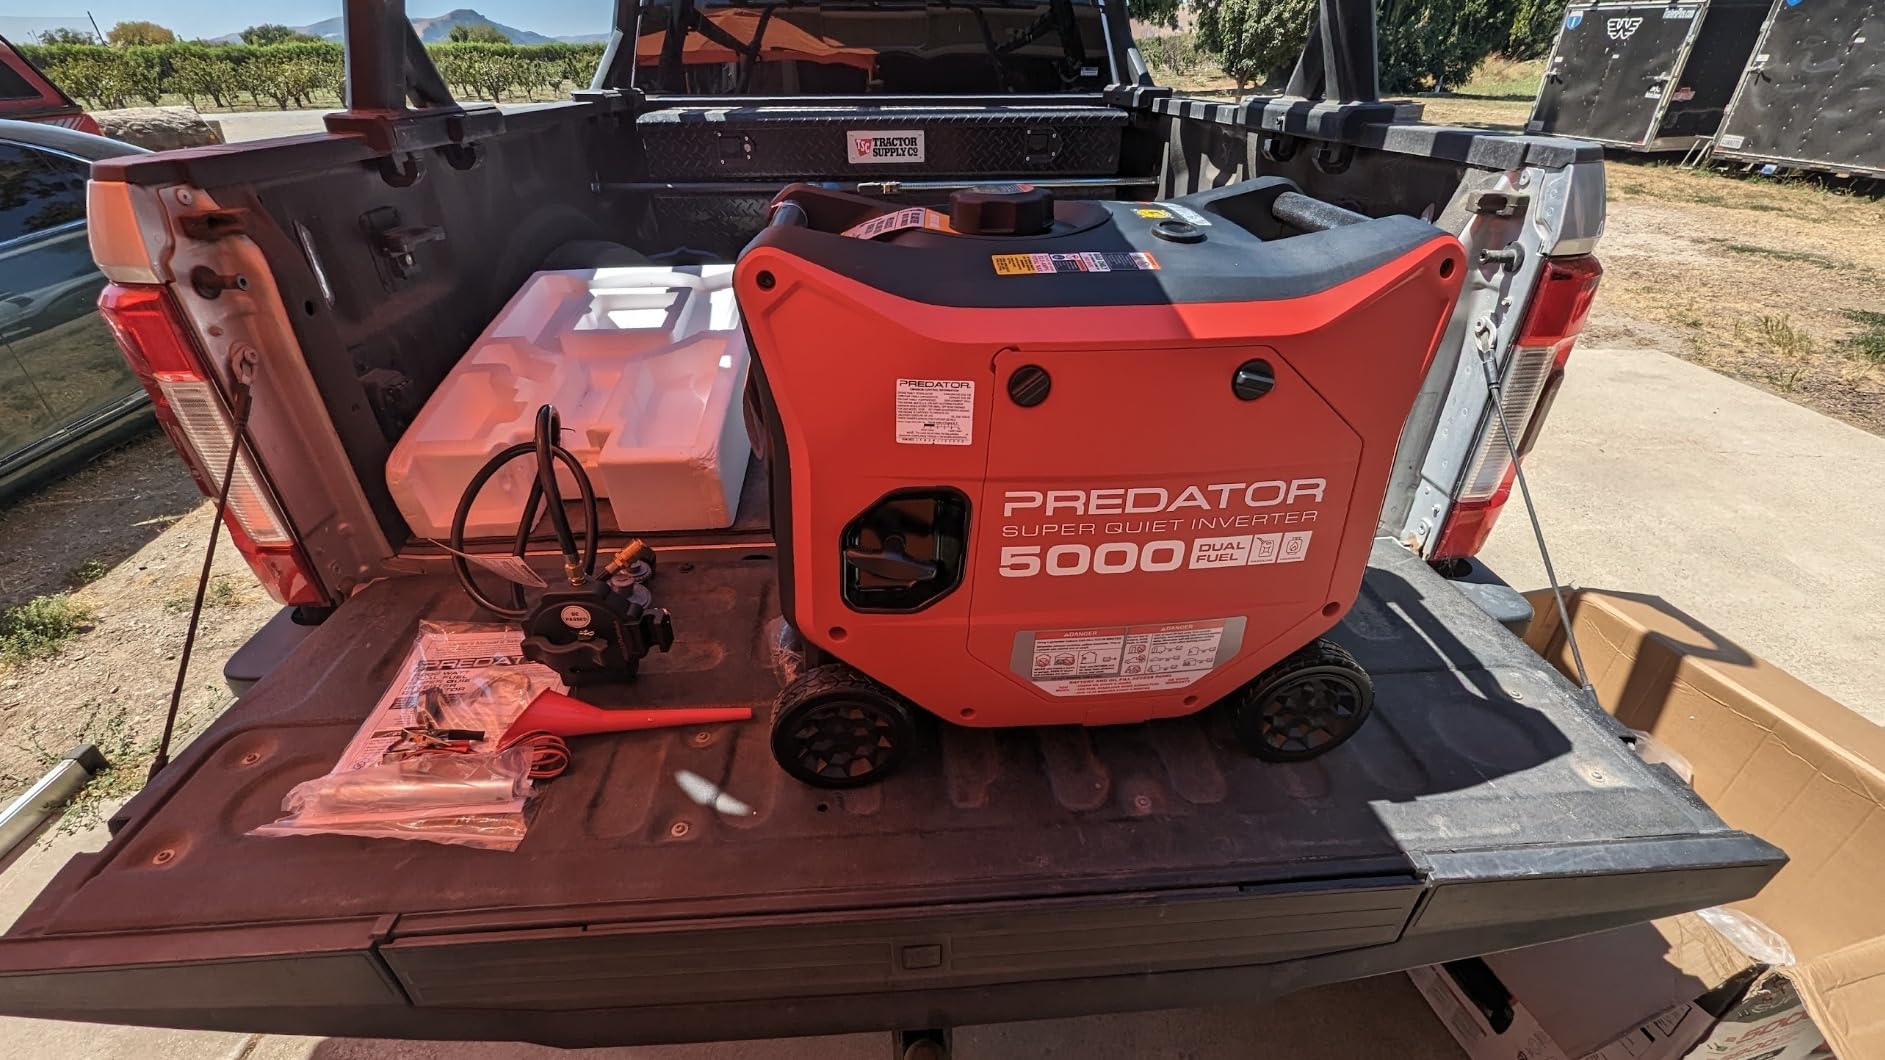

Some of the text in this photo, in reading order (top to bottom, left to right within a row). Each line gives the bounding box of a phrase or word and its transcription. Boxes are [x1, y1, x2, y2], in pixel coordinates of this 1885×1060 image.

[855, 139, 870, 153] TSC
[872, 137, 918, 147] TRACTOR
[872, 147, 908, 157] SUPPLY
[899, 380, 971, 389] PREDATOR
[1003, 478, 1327, 517] PREDATOR
[1001, 510, 1318, 537] SUPER QUIET INVERTER
[1198, 541, 1246, 553] DUAL
[998, 540, 1185, 578] 5000
[1195, 553, 1238, 564] FUEL
[423, 656, 523, 669] PREDAT
